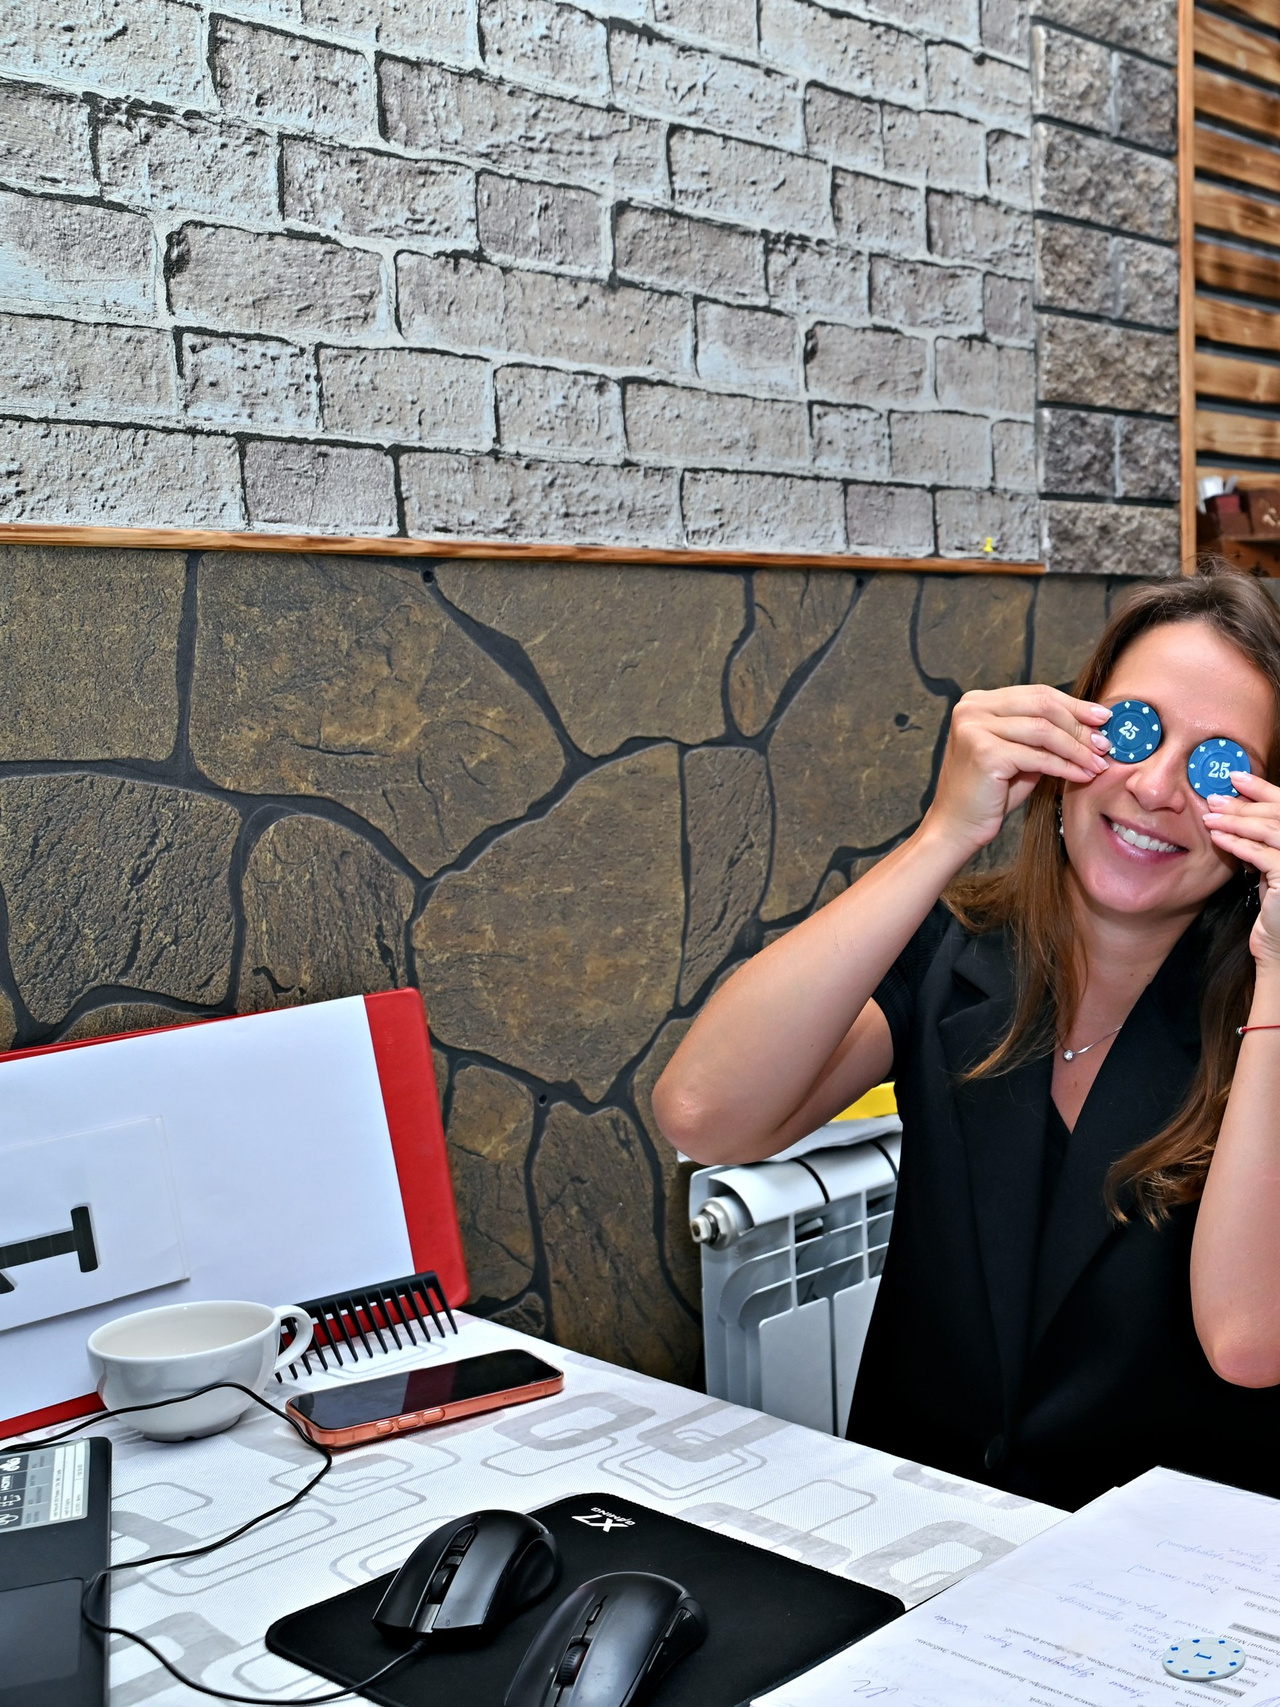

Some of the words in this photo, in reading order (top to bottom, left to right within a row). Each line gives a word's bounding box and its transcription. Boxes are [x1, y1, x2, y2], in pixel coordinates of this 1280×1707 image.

[1118, 720, 1140, 741] 25
[1207, 760, 1231, 780] 25
[571, 1513, 629, 1533] X7
[590, 1506, 636, 1526] GAMING
[1193, 1651, 1213, 1661] 1
